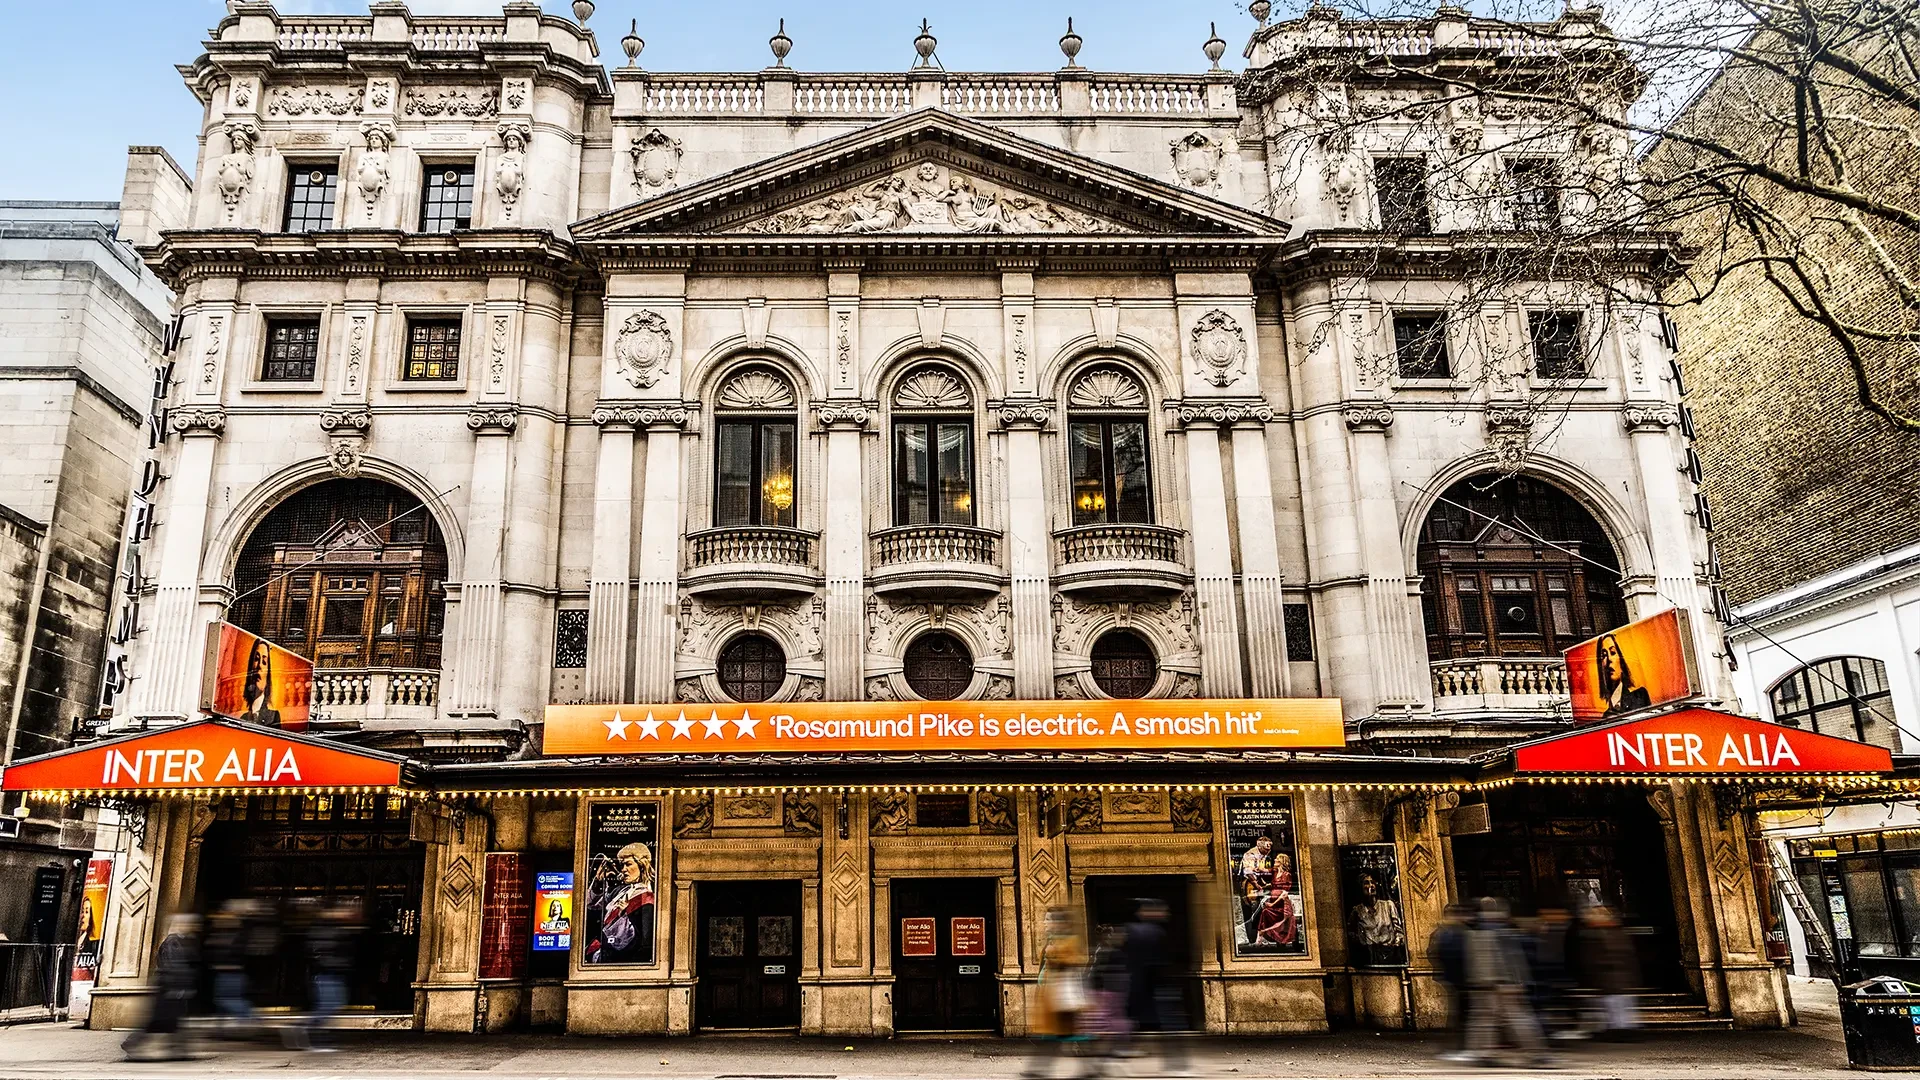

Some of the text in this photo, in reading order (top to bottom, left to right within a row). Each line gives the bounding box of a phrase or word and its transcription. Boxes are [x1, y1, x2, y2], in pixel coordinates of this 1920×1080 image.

[769, 711, 1262, 738] ‘Rosamund Pike is electric. A smash hit’
[102, 747, 302, 784] INTER ALIA
[1607, 732, 1801, 767] INTER ALIA
